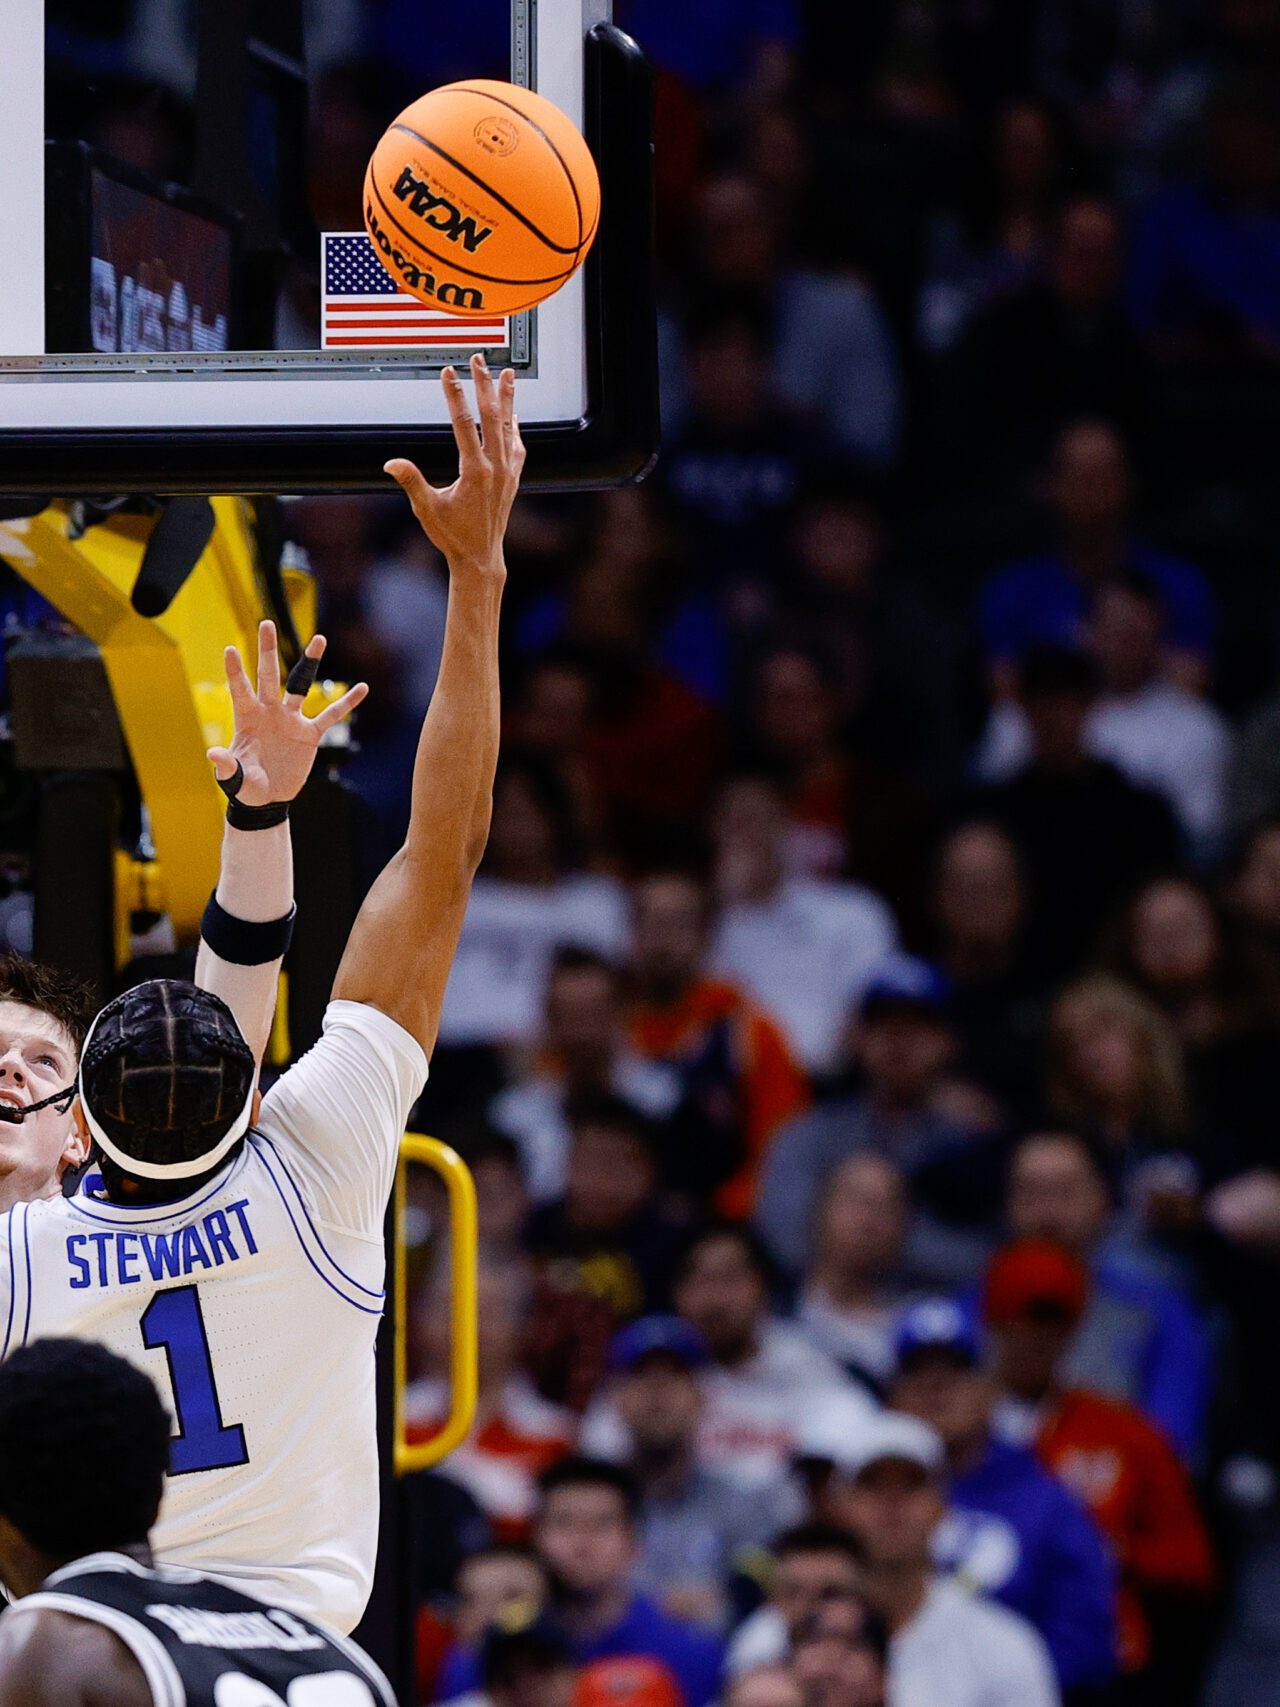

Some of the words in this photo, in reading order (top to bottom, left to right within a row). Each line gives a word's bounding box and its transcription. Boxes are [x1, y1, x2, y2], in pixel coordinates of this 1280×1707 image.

[366, 196, 485, 310] Wilson
[393, 166, 492, 253] NCAA
[66, 1199, 258, 1289] STEWART
[139, 1283, 249, 1477] 1
